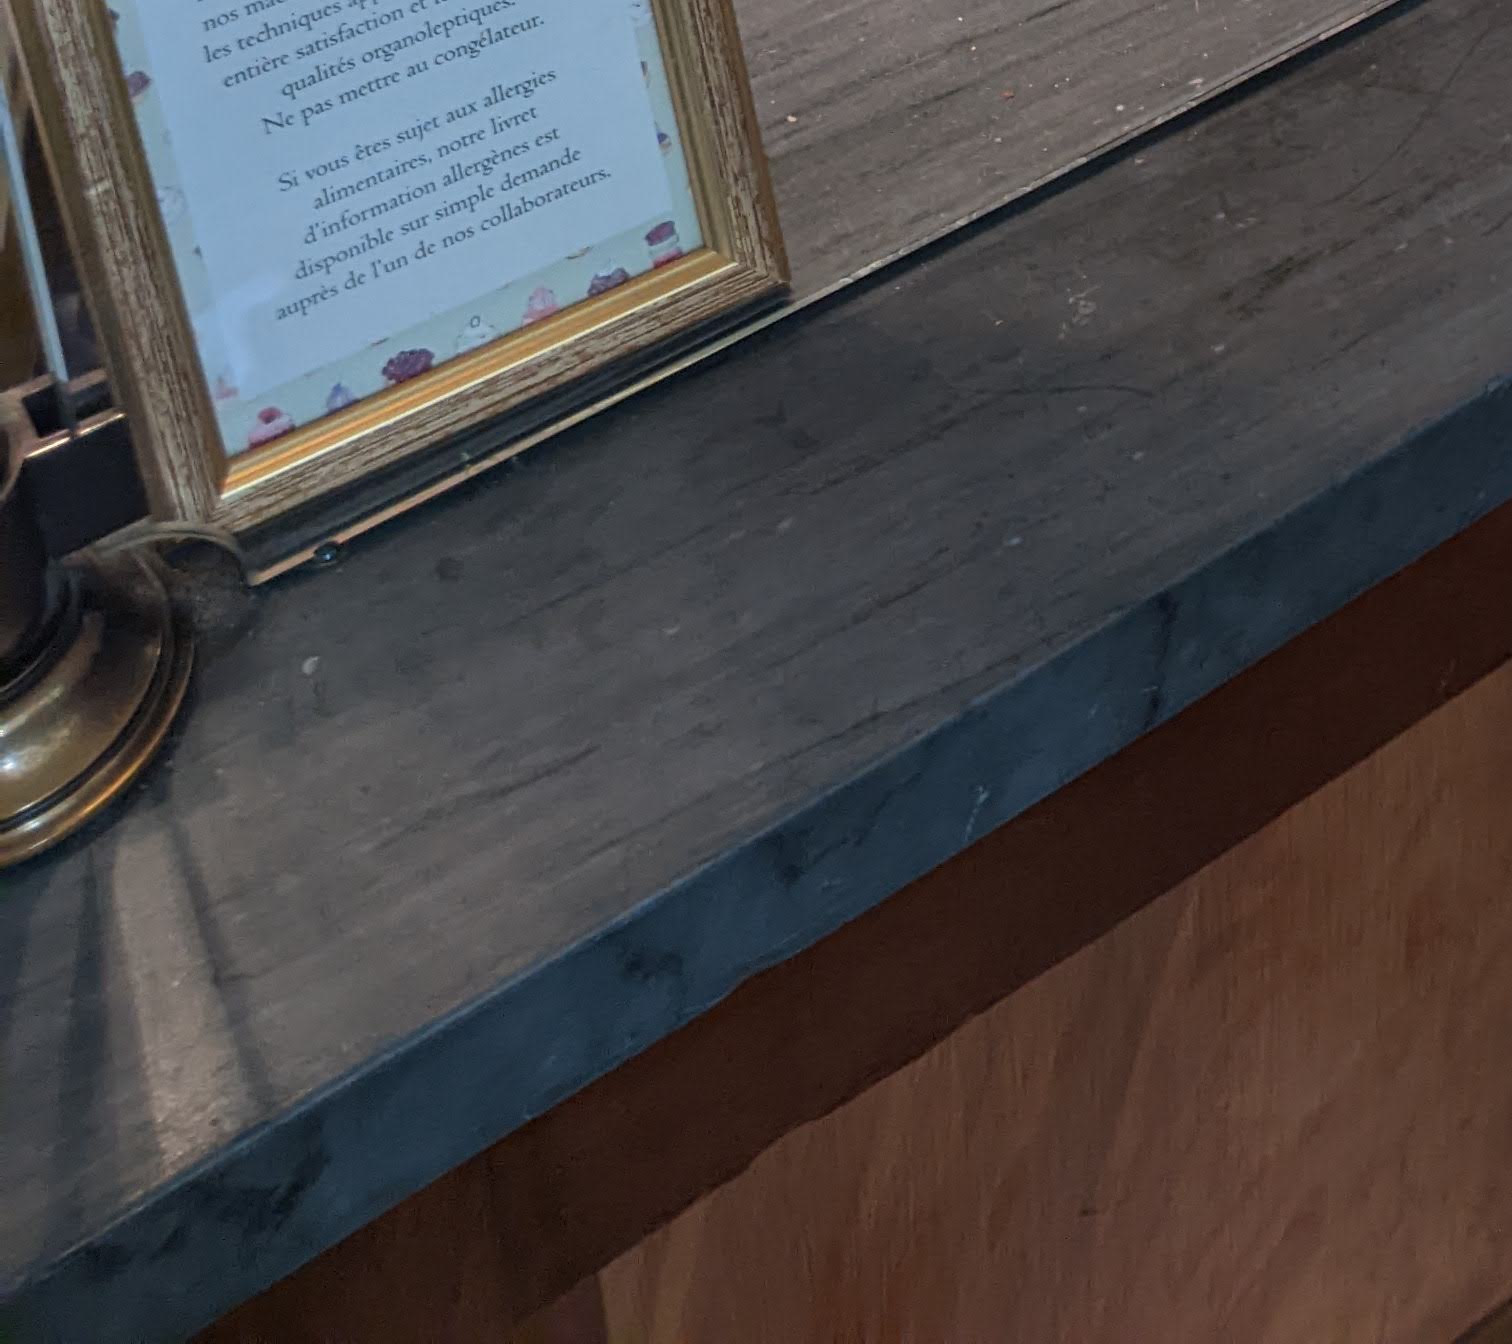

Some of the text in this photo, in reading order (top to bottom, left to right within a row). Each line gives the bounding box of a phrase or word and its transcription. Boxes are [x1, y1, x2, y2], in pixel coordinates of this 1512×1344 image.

[202, 9, 239, 32] nos
[203, 45, 232, 63] les
[237, 2, 342, 50] techniques
[223, 54, 289, 87] entière
[296, 9, 404, 59] satisfaction
[261, 16, 544, 134] Ne pas mettre au congélateur.
[278, 71, 556, 191] Si vous êtes sujet aux allergies
[281, 57, 356, 100] qualités
[304, 128, 560, 244] d'information allergènes est
[314, 107, 537, 209] alimentaires, notre livret
[277, 169, 611, 320] auprès de l'un de nos collaborateurs.
[295, 147, 580, 279] disponible sur simple demande
